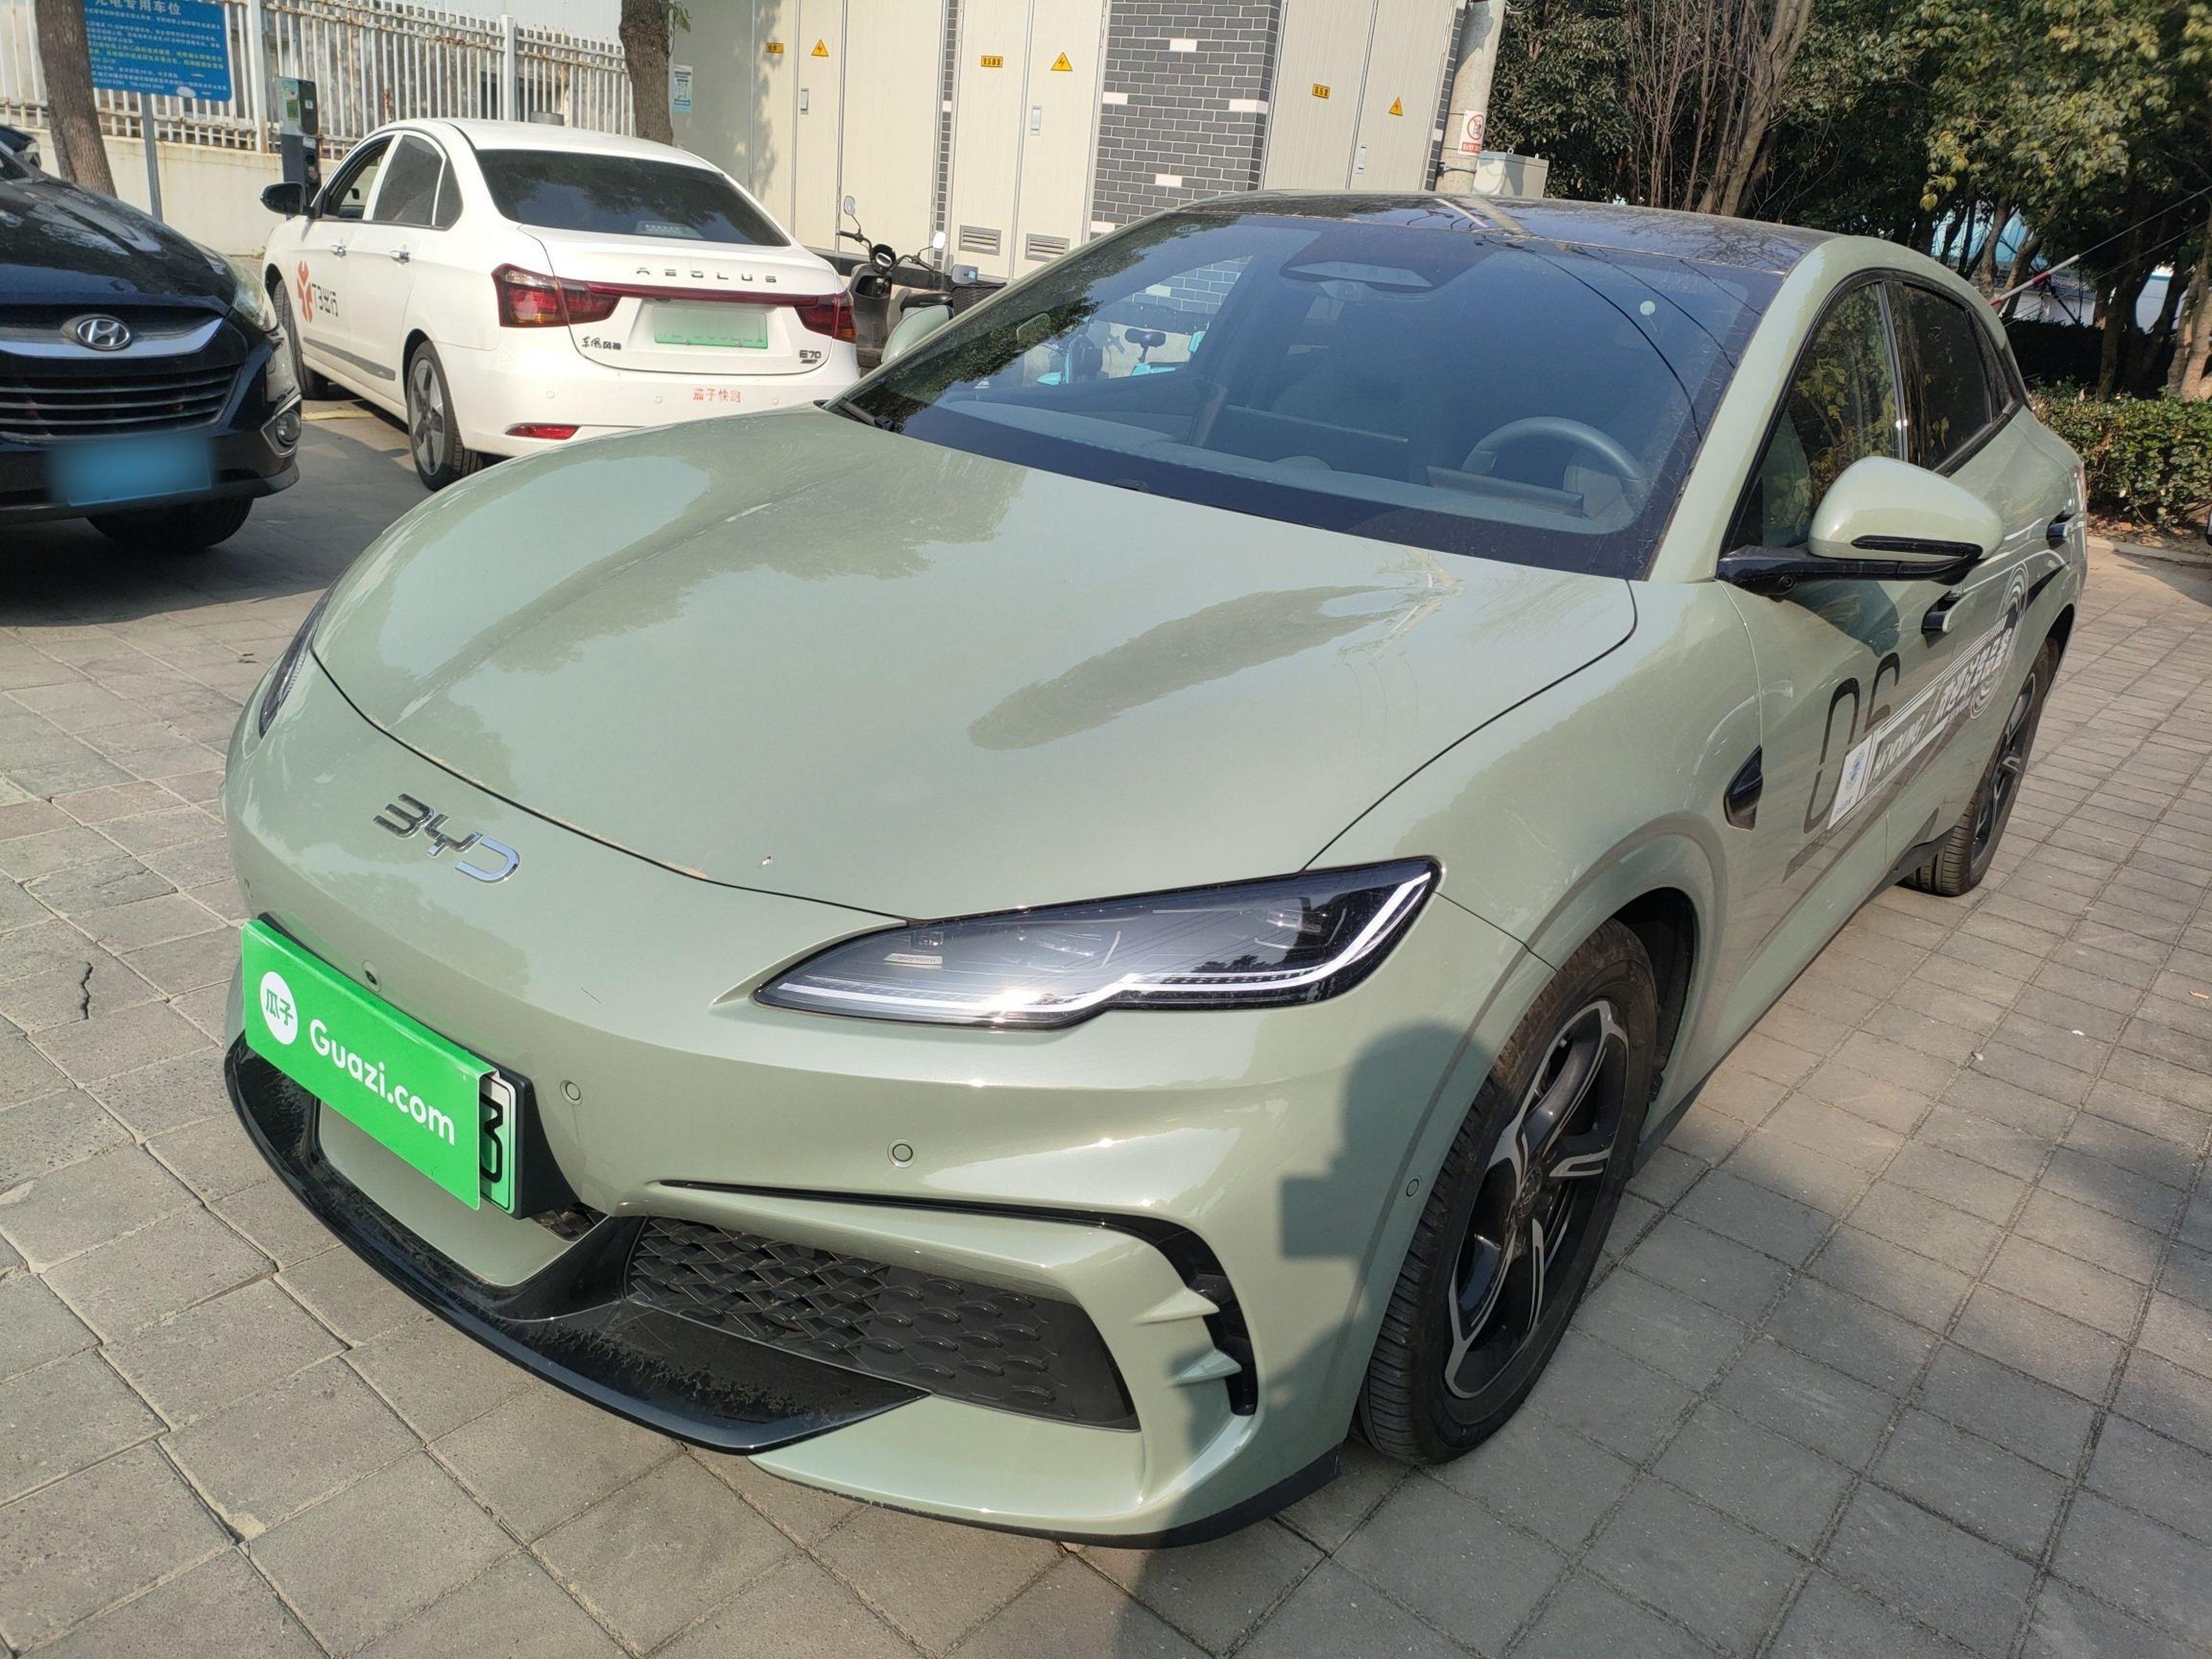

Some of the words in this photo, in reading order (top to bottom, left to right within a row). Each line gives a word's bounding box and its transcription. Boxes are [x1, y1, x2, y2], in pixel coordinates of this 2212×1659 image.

[636, 267, 777, 283] AEOLUS
[800, 350, 821, 358] E70
[693, 388, 741, 403] 茄子快跑
[373, 793, 520, 884] BYD
[266, 987, 294, 1026] 瓜子
[309, 1018, 455, 1146] Guazi.com
